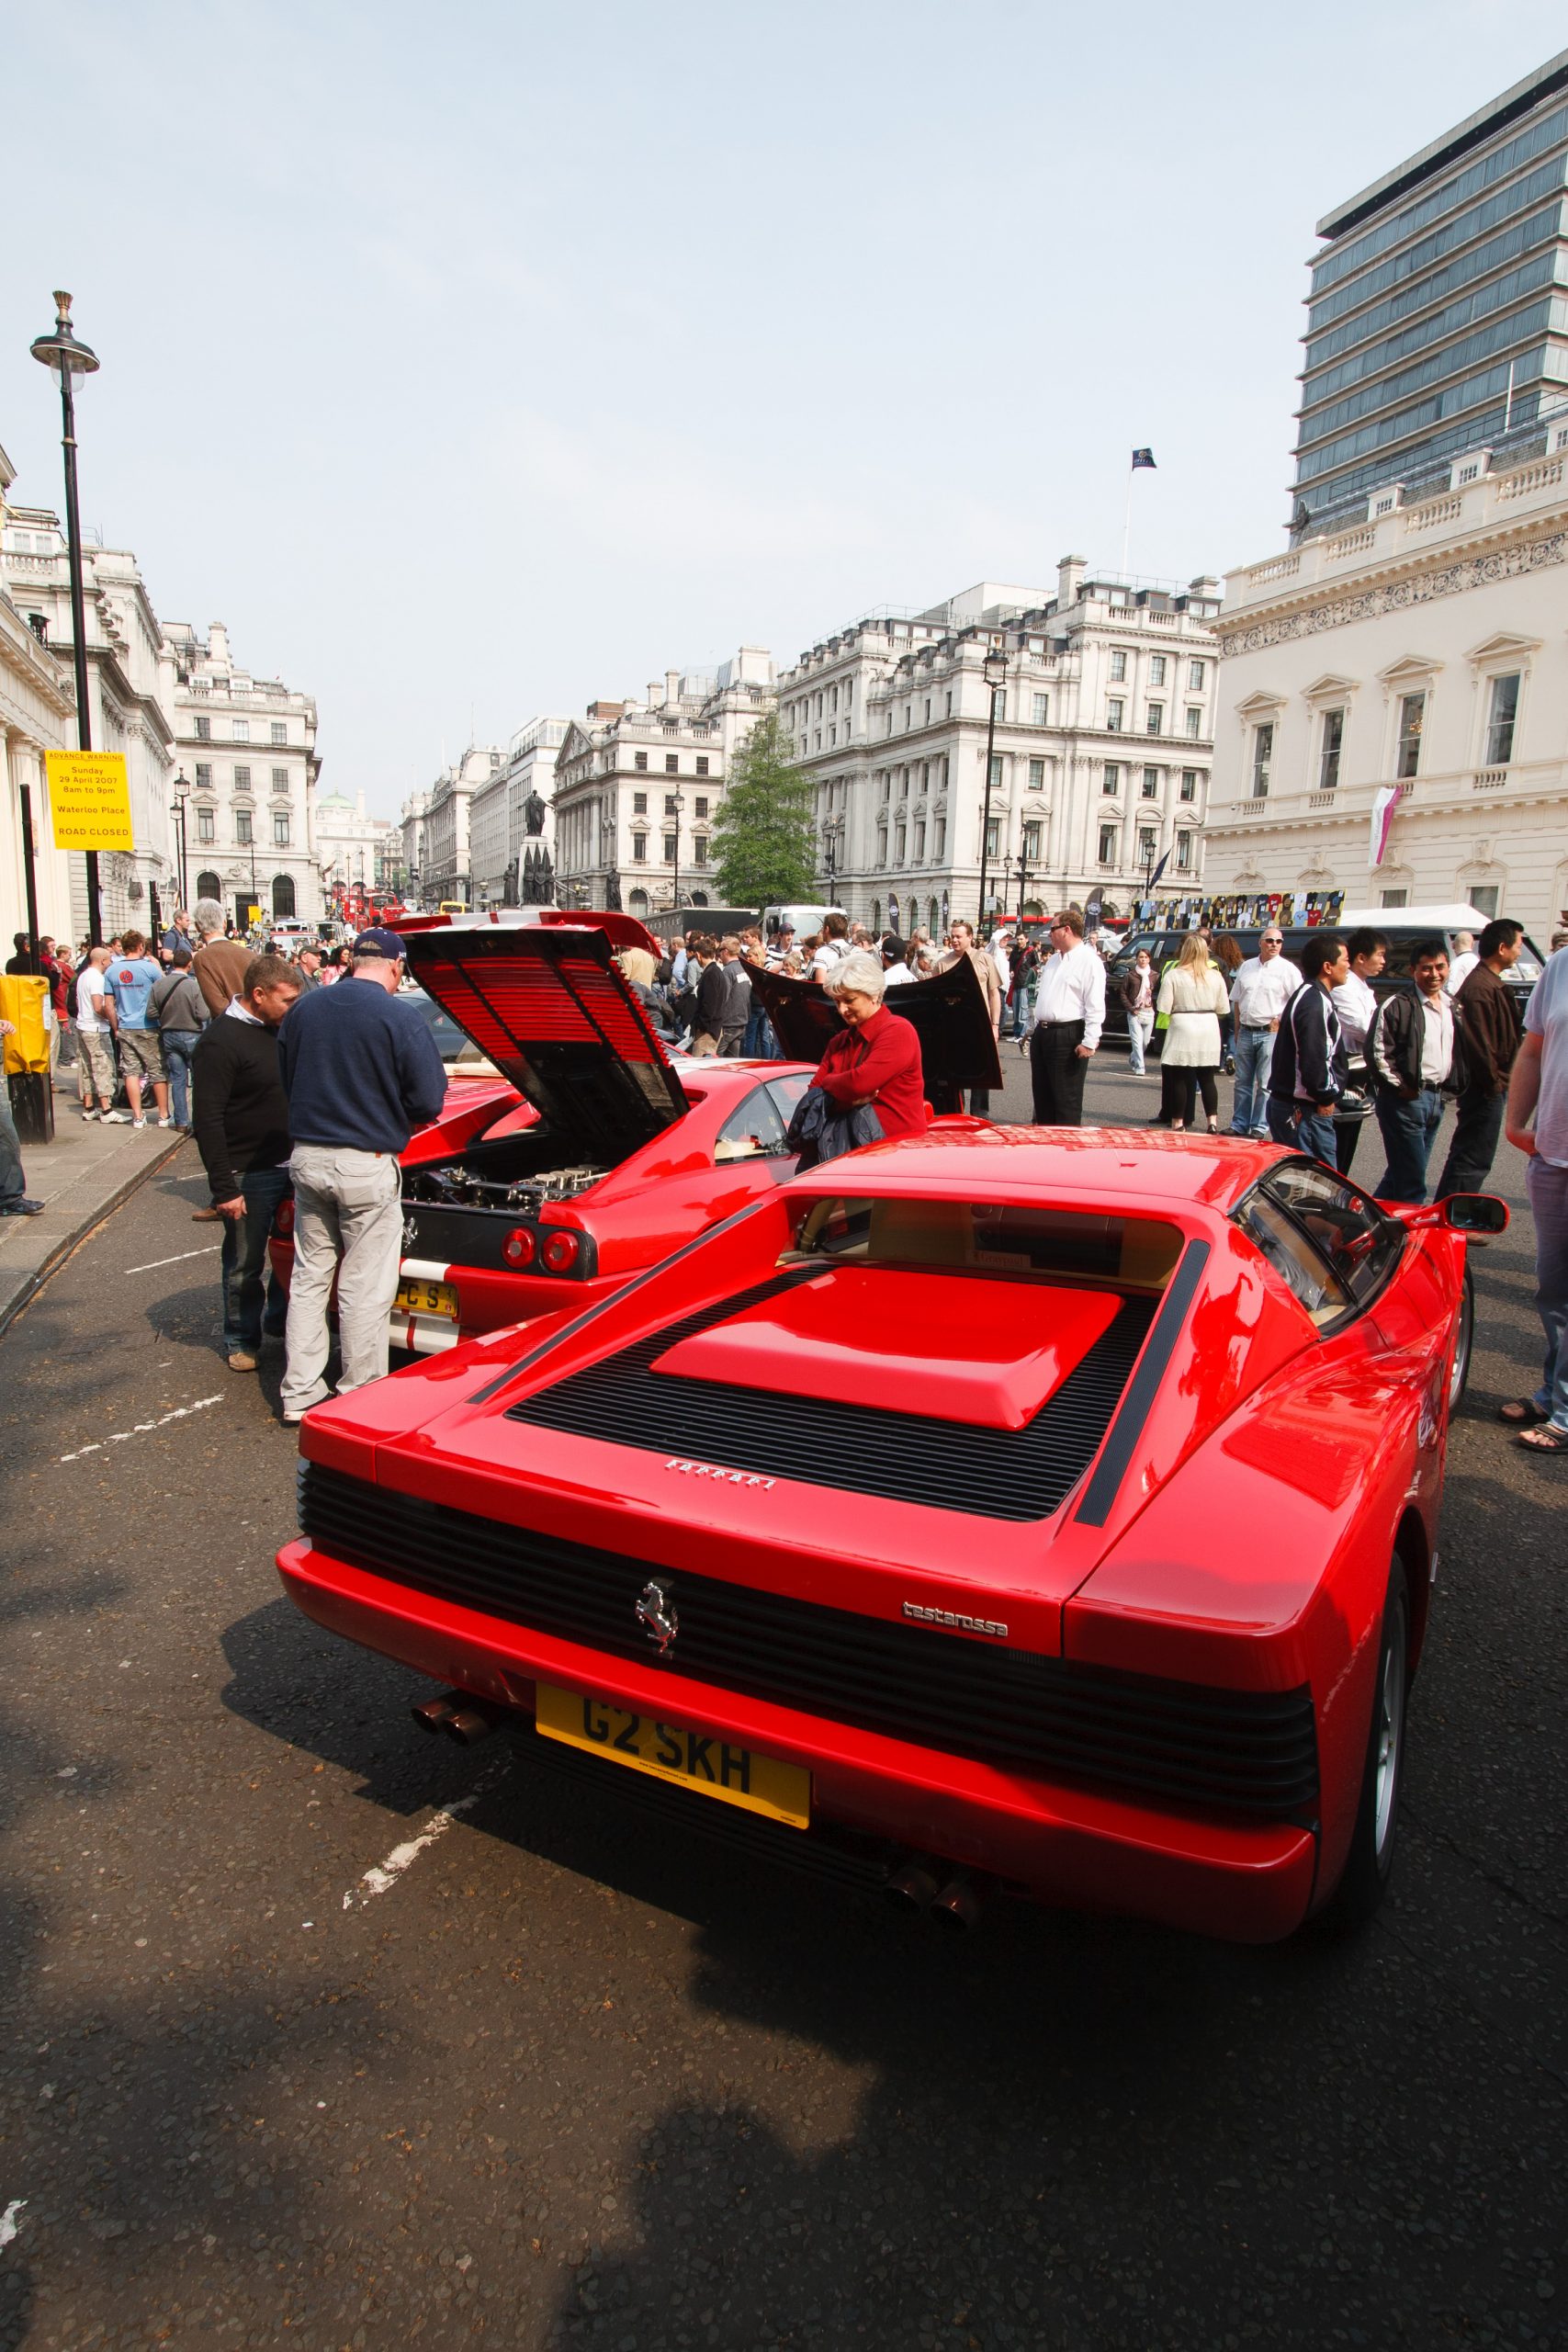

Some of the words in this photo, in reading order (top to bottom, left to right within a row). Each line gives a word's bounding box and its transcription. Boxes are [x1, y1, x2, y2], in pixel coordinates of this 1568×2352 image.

[72, 766, 104, 775] Sunday
[96, 786, 116, 795] 9pm
[57, 805, 98, 814] Waterloo
[101, 807, 125, 815] Place
[89, 828, 129, 836] CLOSED
[583, 1698, 639, 1755] G2
[656, 1722, 750, 1794] SKH
